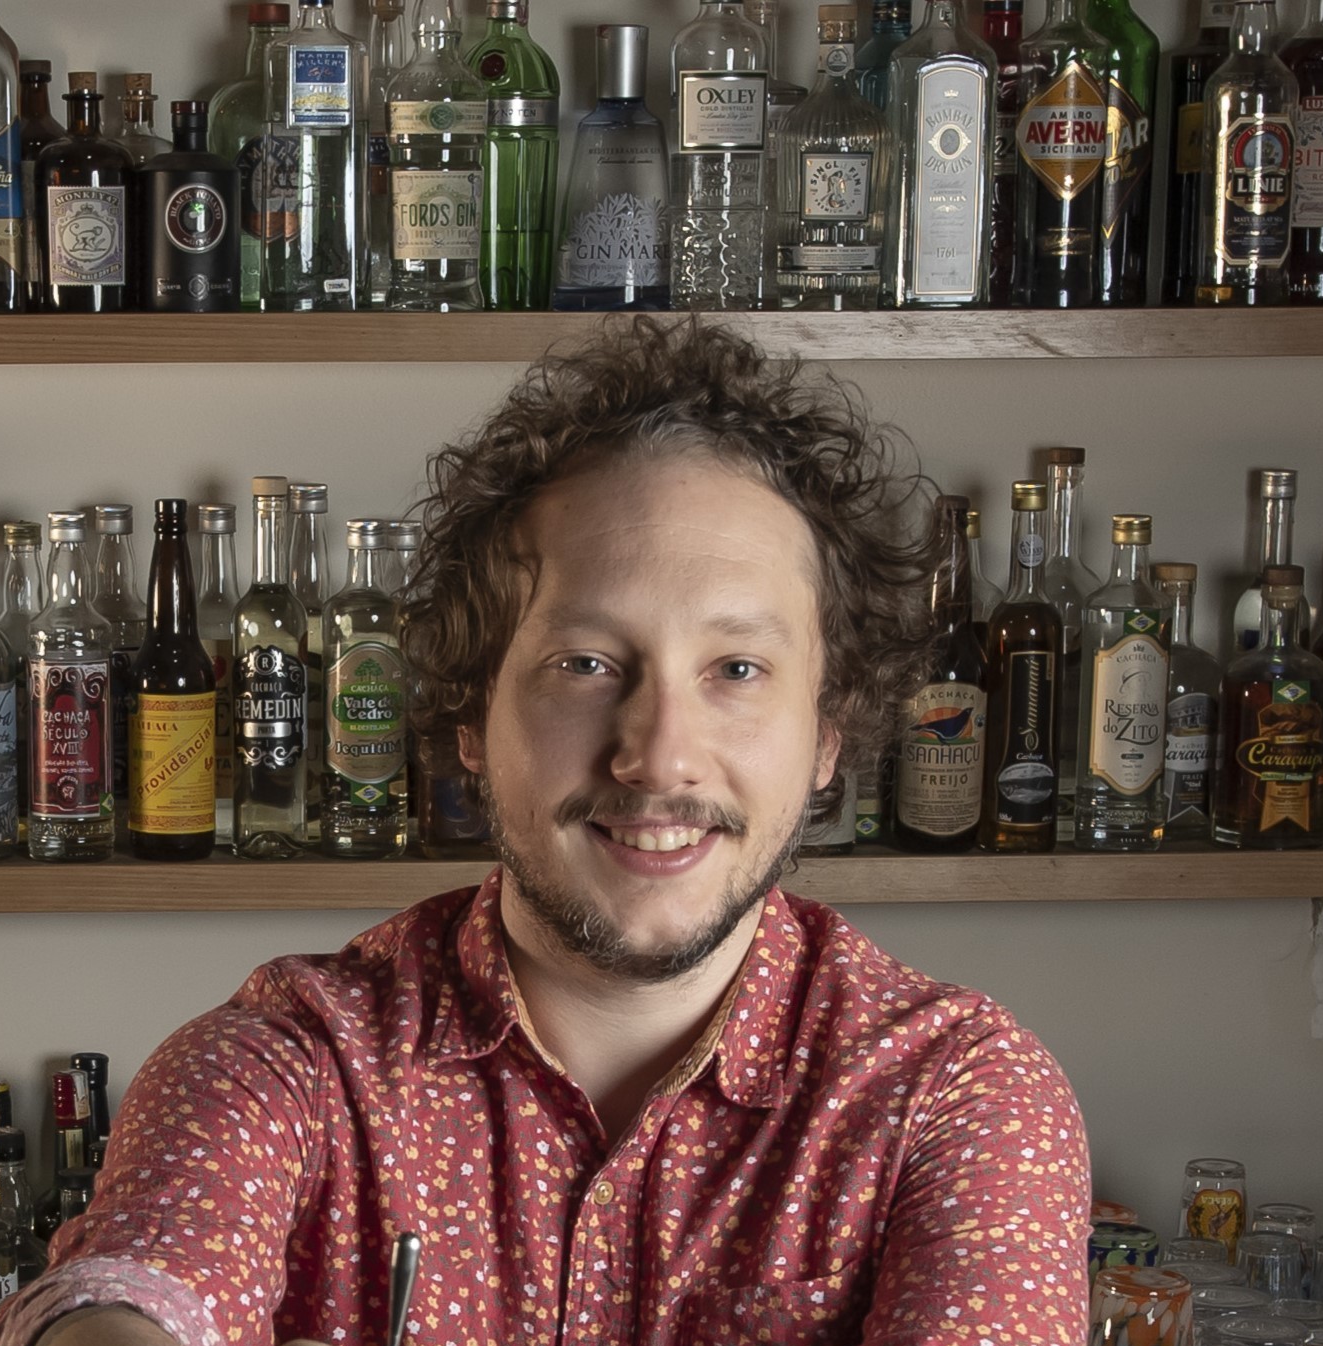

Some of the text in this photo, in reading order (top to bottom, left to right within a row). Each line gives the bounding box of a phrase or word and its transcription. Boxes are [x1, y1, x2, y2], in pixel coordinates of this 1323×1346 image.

[697, 87, 756, 105] OXLEY
[1050, 111, 1092, 120] AMRO
[1026, 120, 1107, 145] AVERNA
[1040, 144, 1097, 154] SICIIANO
[56, 193, 105, 206] MONKEY
[170, 191, 193, 217] BLACK
[401, 203, 478, 227] FORDS GIN
[576, 243, 611, 259] GIN
[935, 246, 958, 259] 1761
[262, 656, 270, 668] R
[343, 695, 375, 709] Vale
[1104, 699, 1160, 718] RESERVA
[42, 710, 91, 727] CACHAÇA
[347, 707, 393, 720] Cedro
[42, 724, 88, 741] SÉCULO
[1102, 716, 1160, 746] do ZITO
[336, 739, 403, 756] Jequitib
[905, 743, 982, 765] SANHAÇU
[920, 769, 968, 785] FREIJÓ
